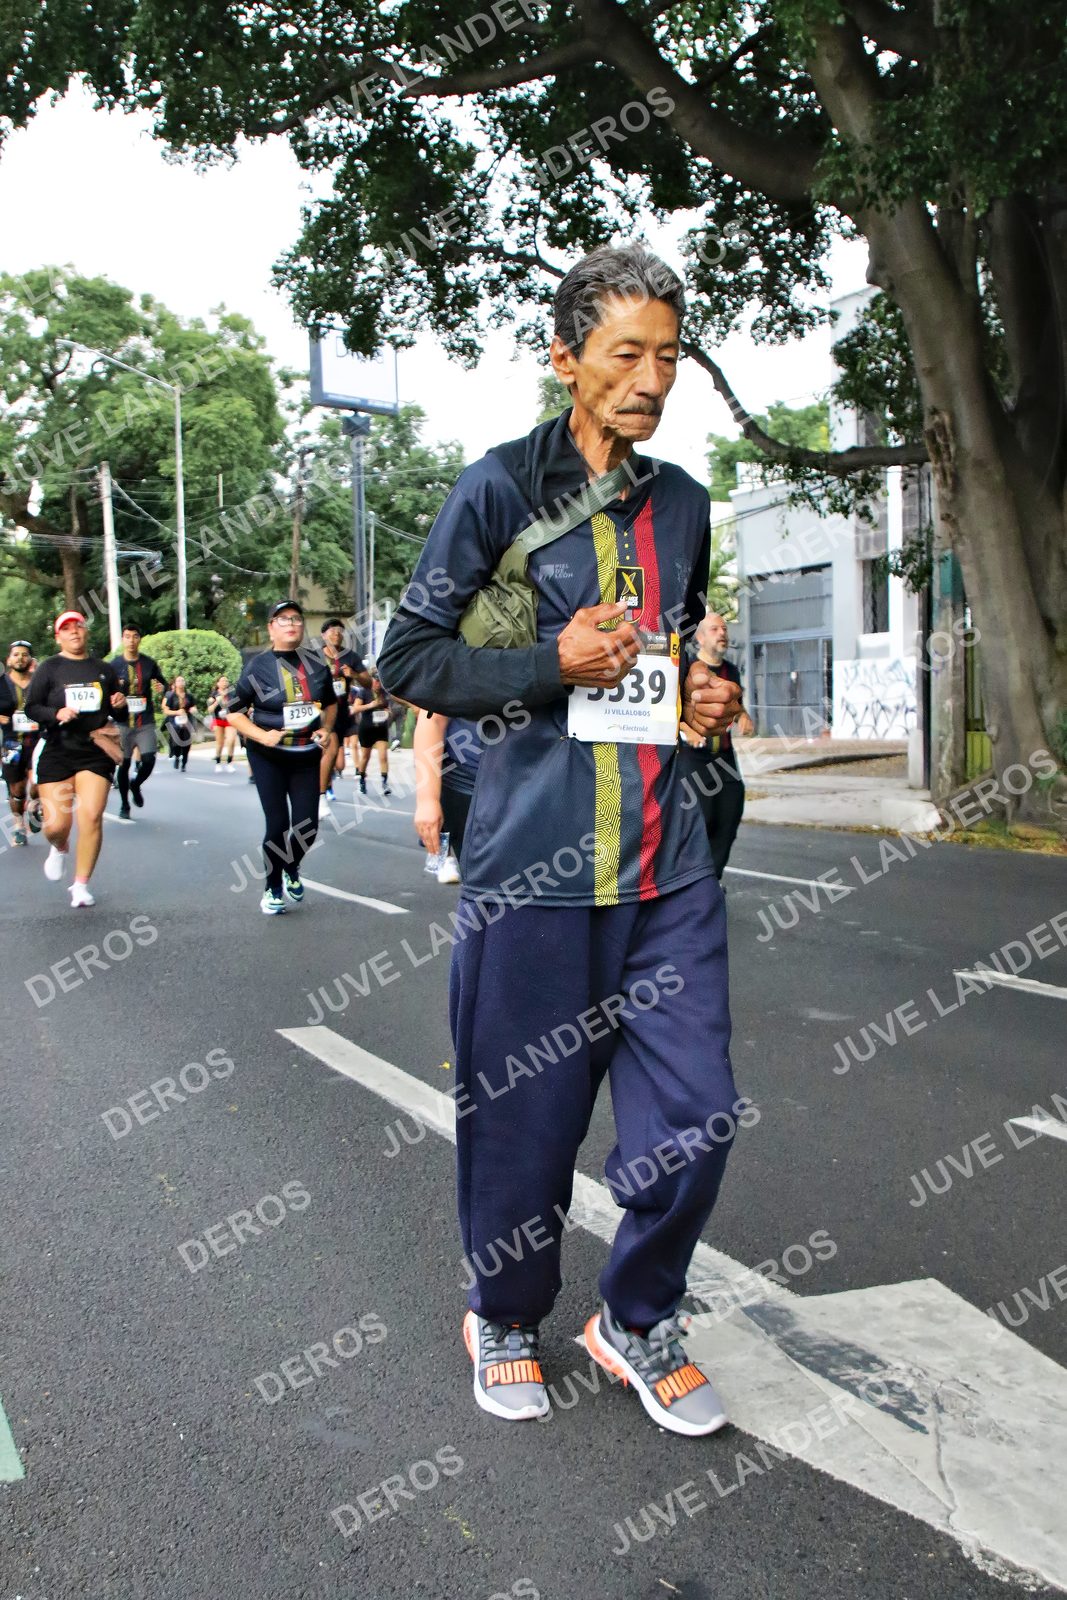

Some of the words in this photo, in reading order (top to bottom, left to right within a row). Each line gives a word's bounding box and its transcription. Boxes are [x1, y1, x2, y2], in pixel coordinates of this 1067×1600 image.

[72, 691, 95, 700] 1674
[290, 706, 313, 720] 3290
[611, 709, 651, 717] VILLALOBOS
